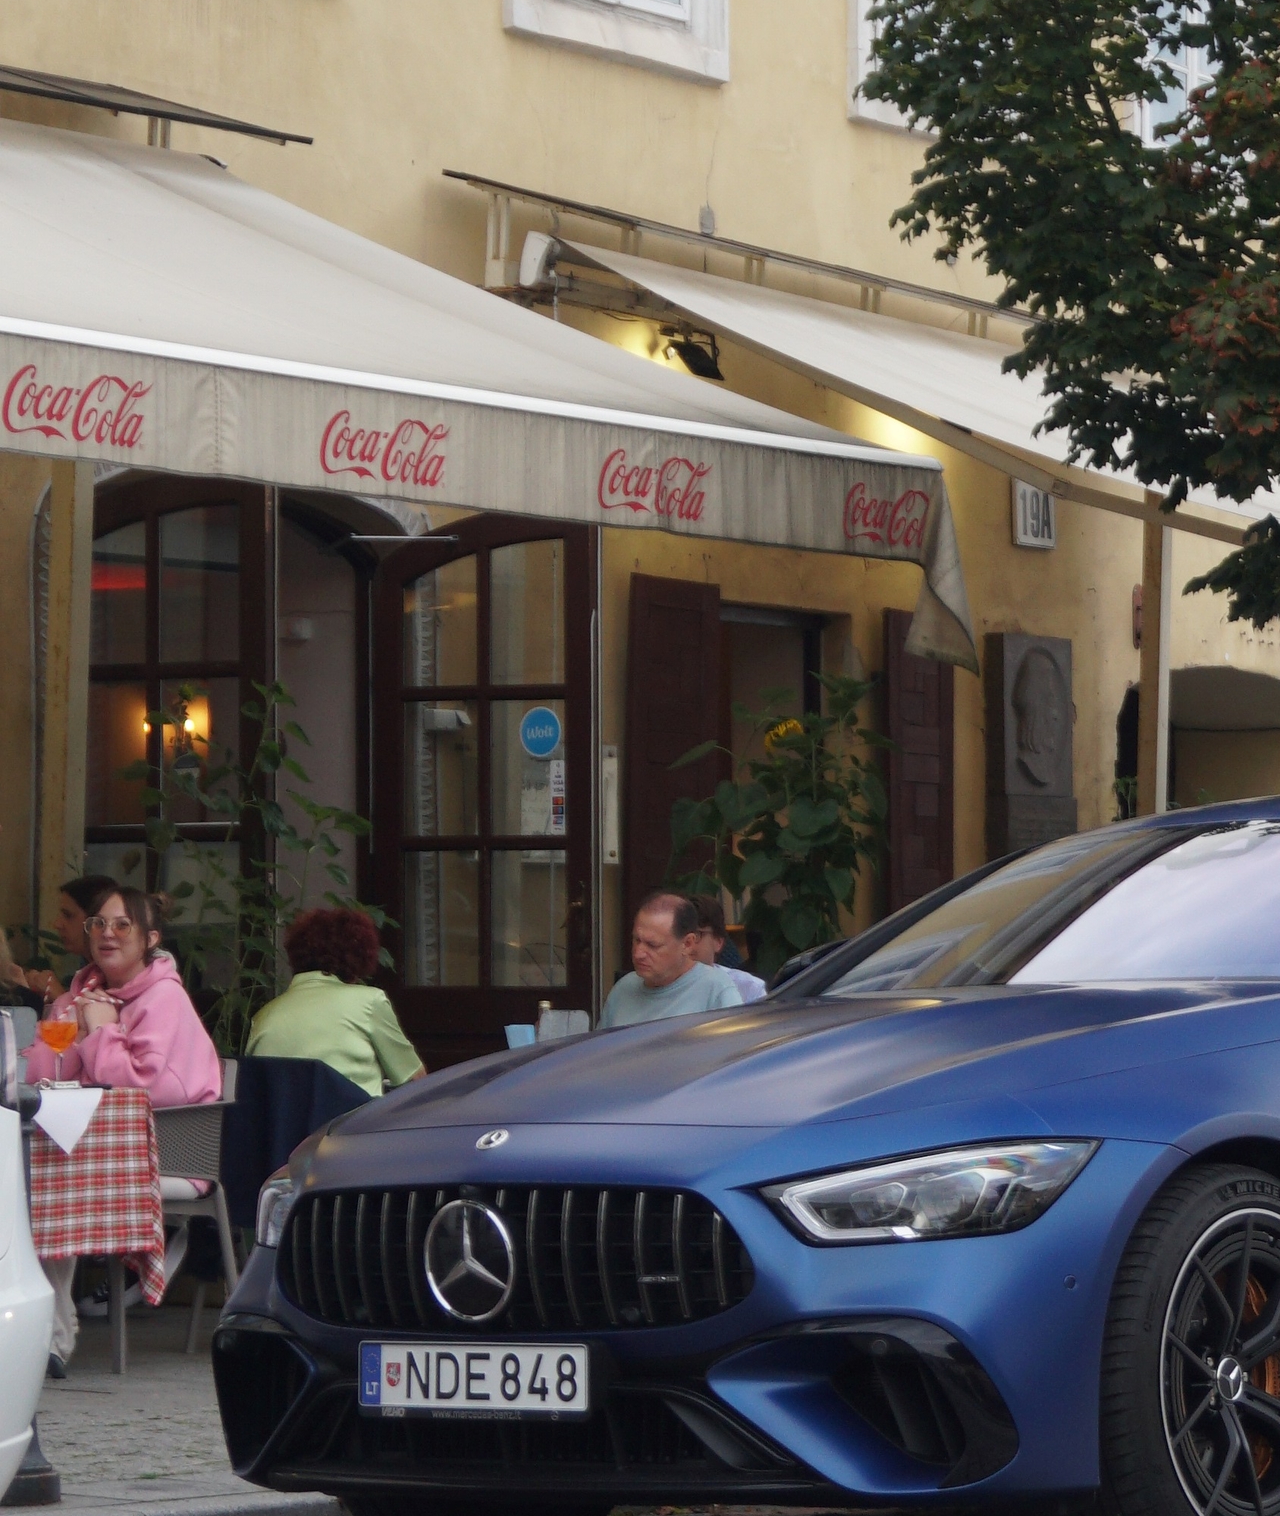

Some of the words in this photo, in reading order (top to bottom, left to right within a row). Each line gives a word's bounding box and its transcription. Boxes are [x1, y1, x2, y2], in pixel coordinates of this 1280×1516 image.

[2, 364, 153, 448] Coca-Cola
[319, 409, 450, 487] Coca-Cola
[597, 448, 713, 521] Coca-Cola
[1020, 488, 1052, 539] 19A
[527, 725, 554, 740] Wolt
[365, 1381, 379, 1395] LT
